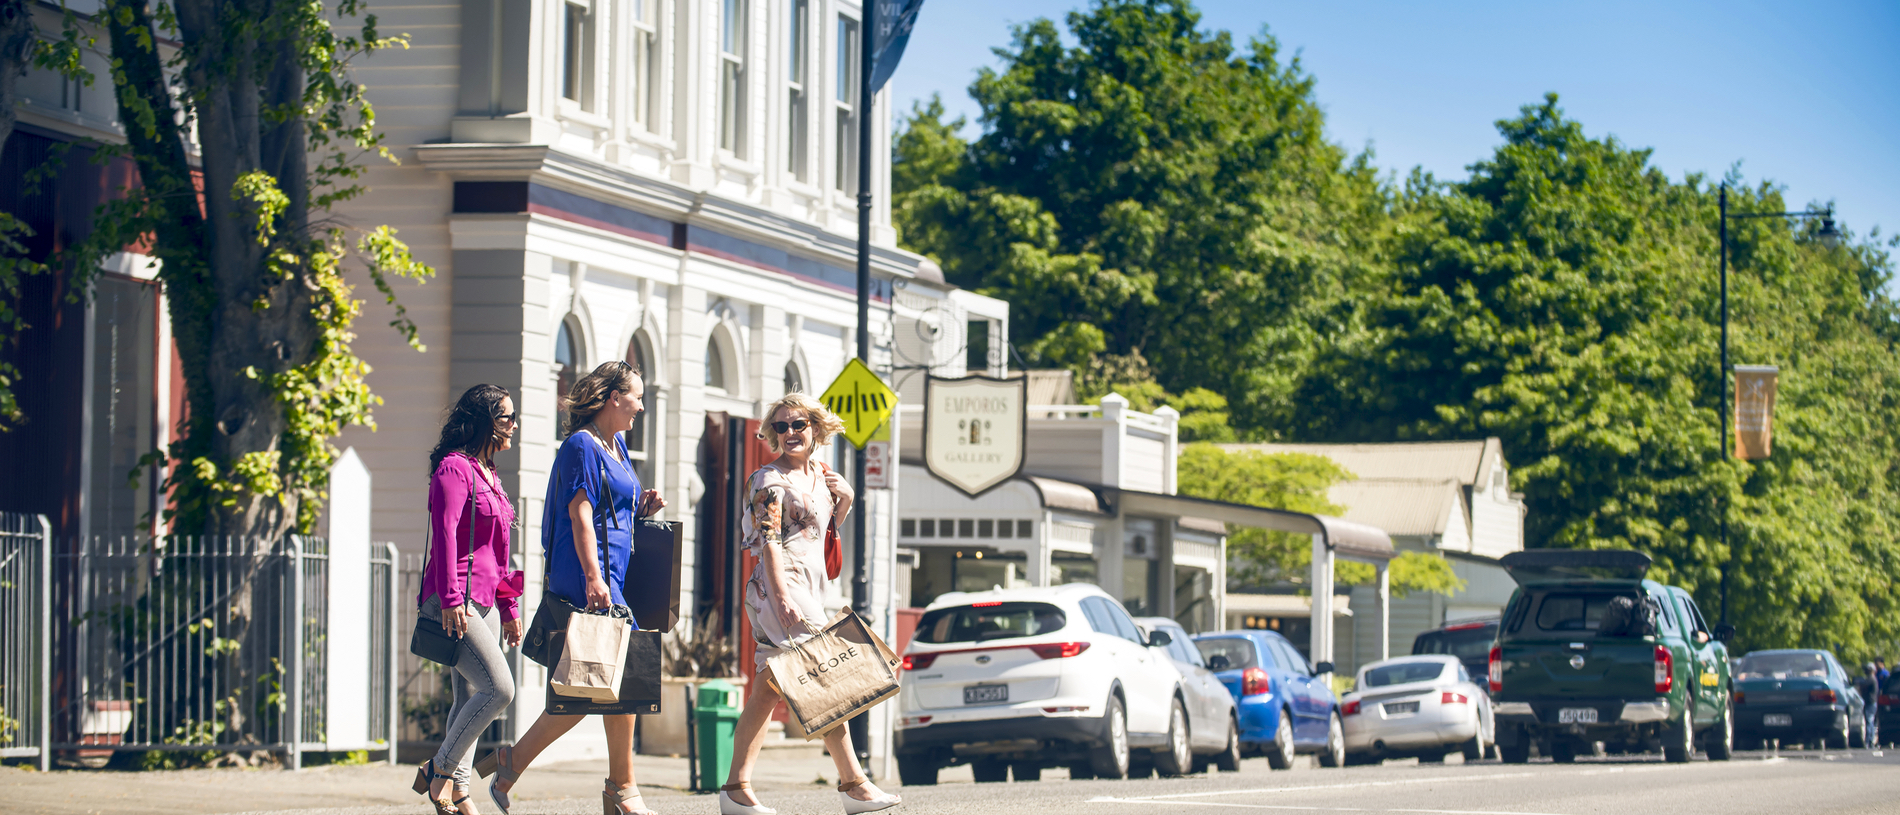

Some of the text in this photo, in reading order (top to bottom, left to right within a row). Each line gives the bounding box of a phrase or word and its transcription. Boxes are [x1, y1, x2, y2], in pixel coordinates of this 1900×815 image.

[944, 396, 1008, 414] EMPOROS
[944, 452, 1003, 464] GALLERY
[797, 646, 858, 685] ENCORE
